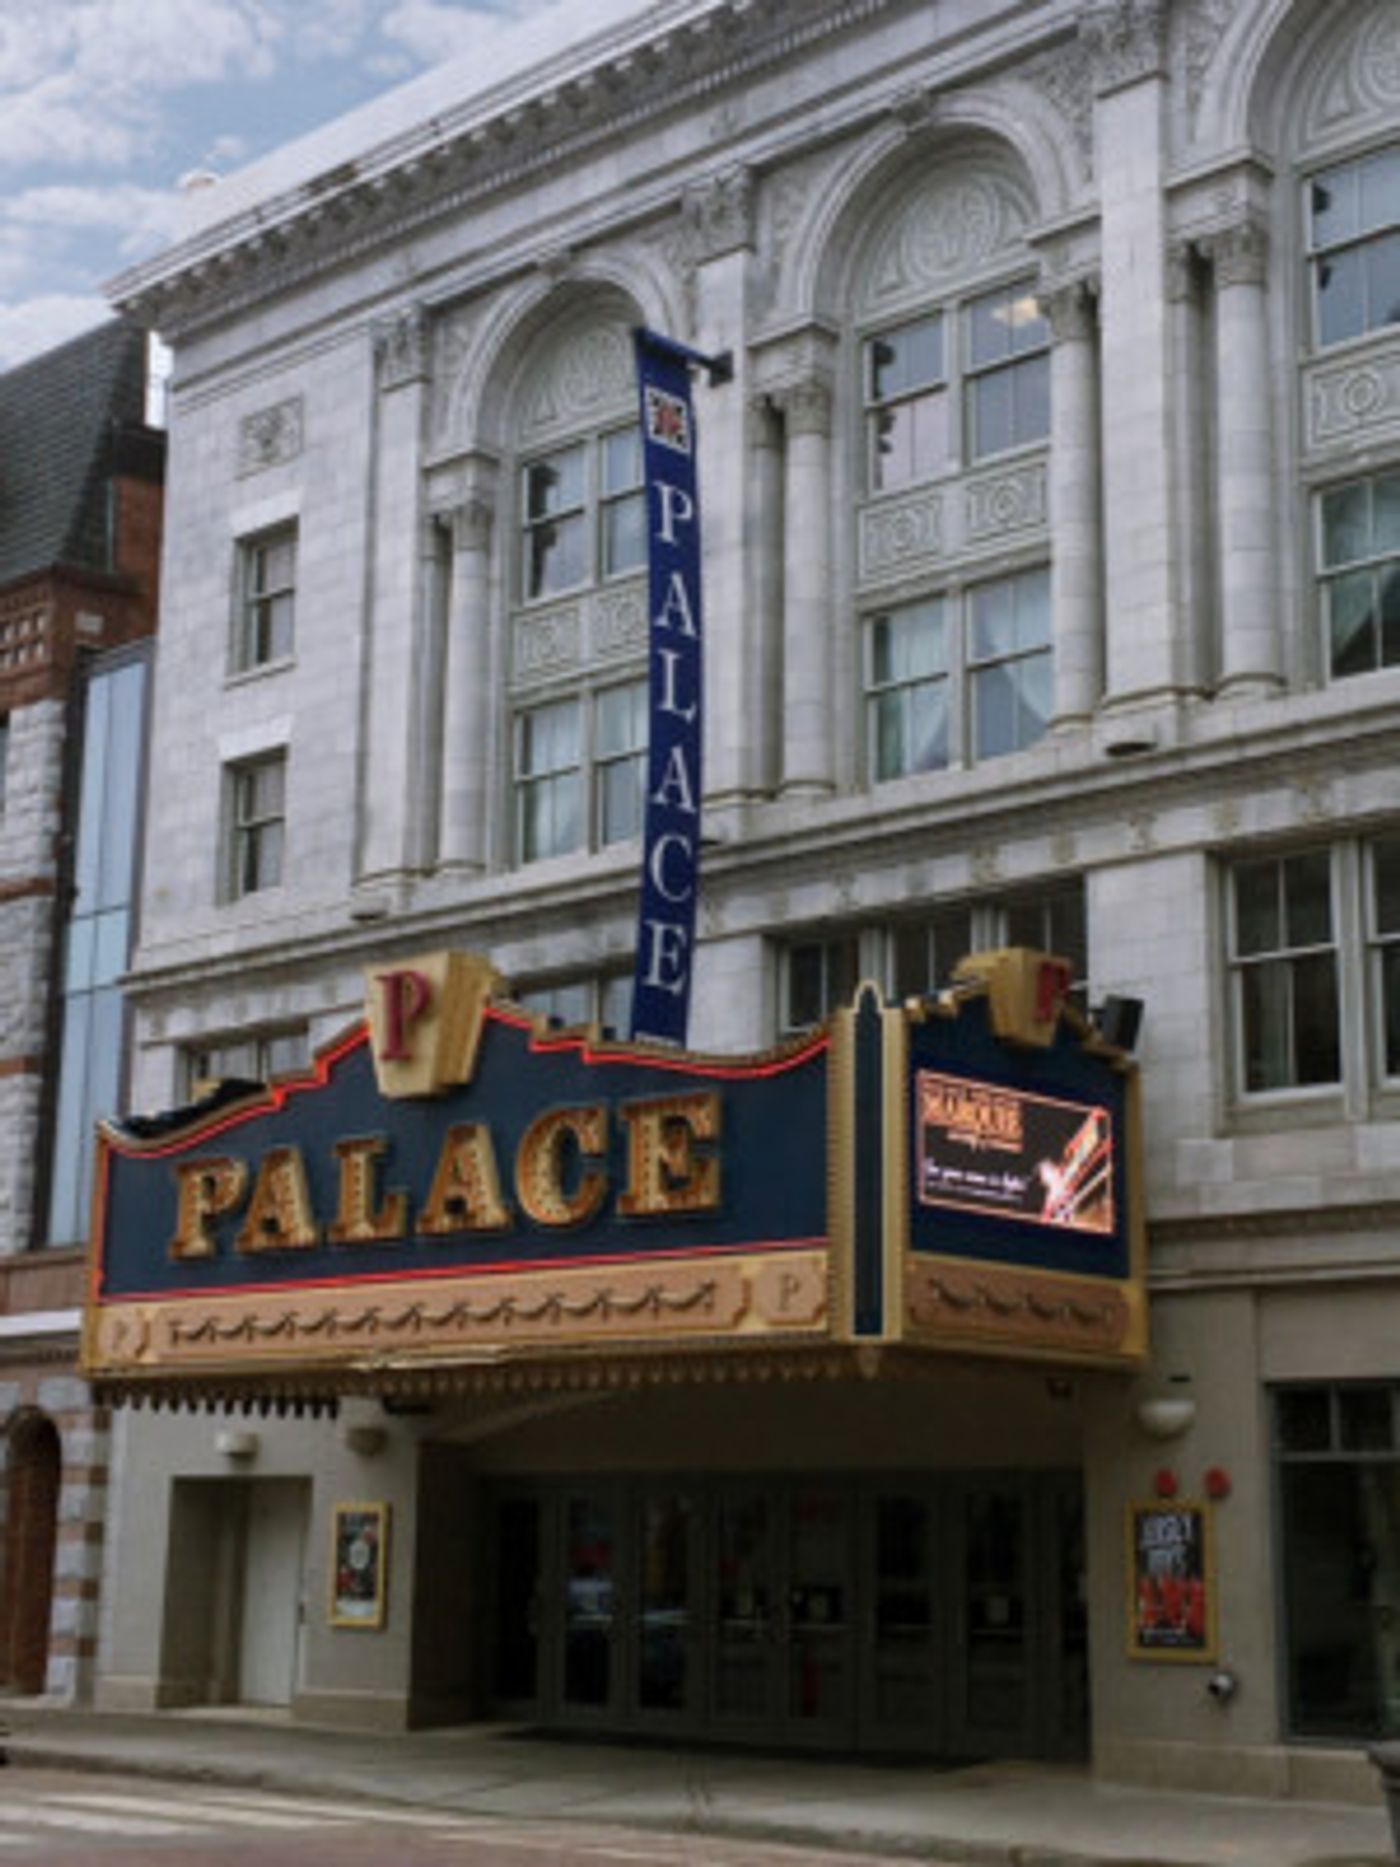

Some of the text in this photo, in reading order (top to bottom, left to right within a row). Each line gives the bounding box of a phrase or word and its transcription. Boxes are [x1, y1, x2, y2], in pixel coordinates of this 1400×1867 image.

[642, 481, 697, 995] PALACE
[374, 970, 433, 1063] P
[170, 1093, 721, 1259] PALACE
